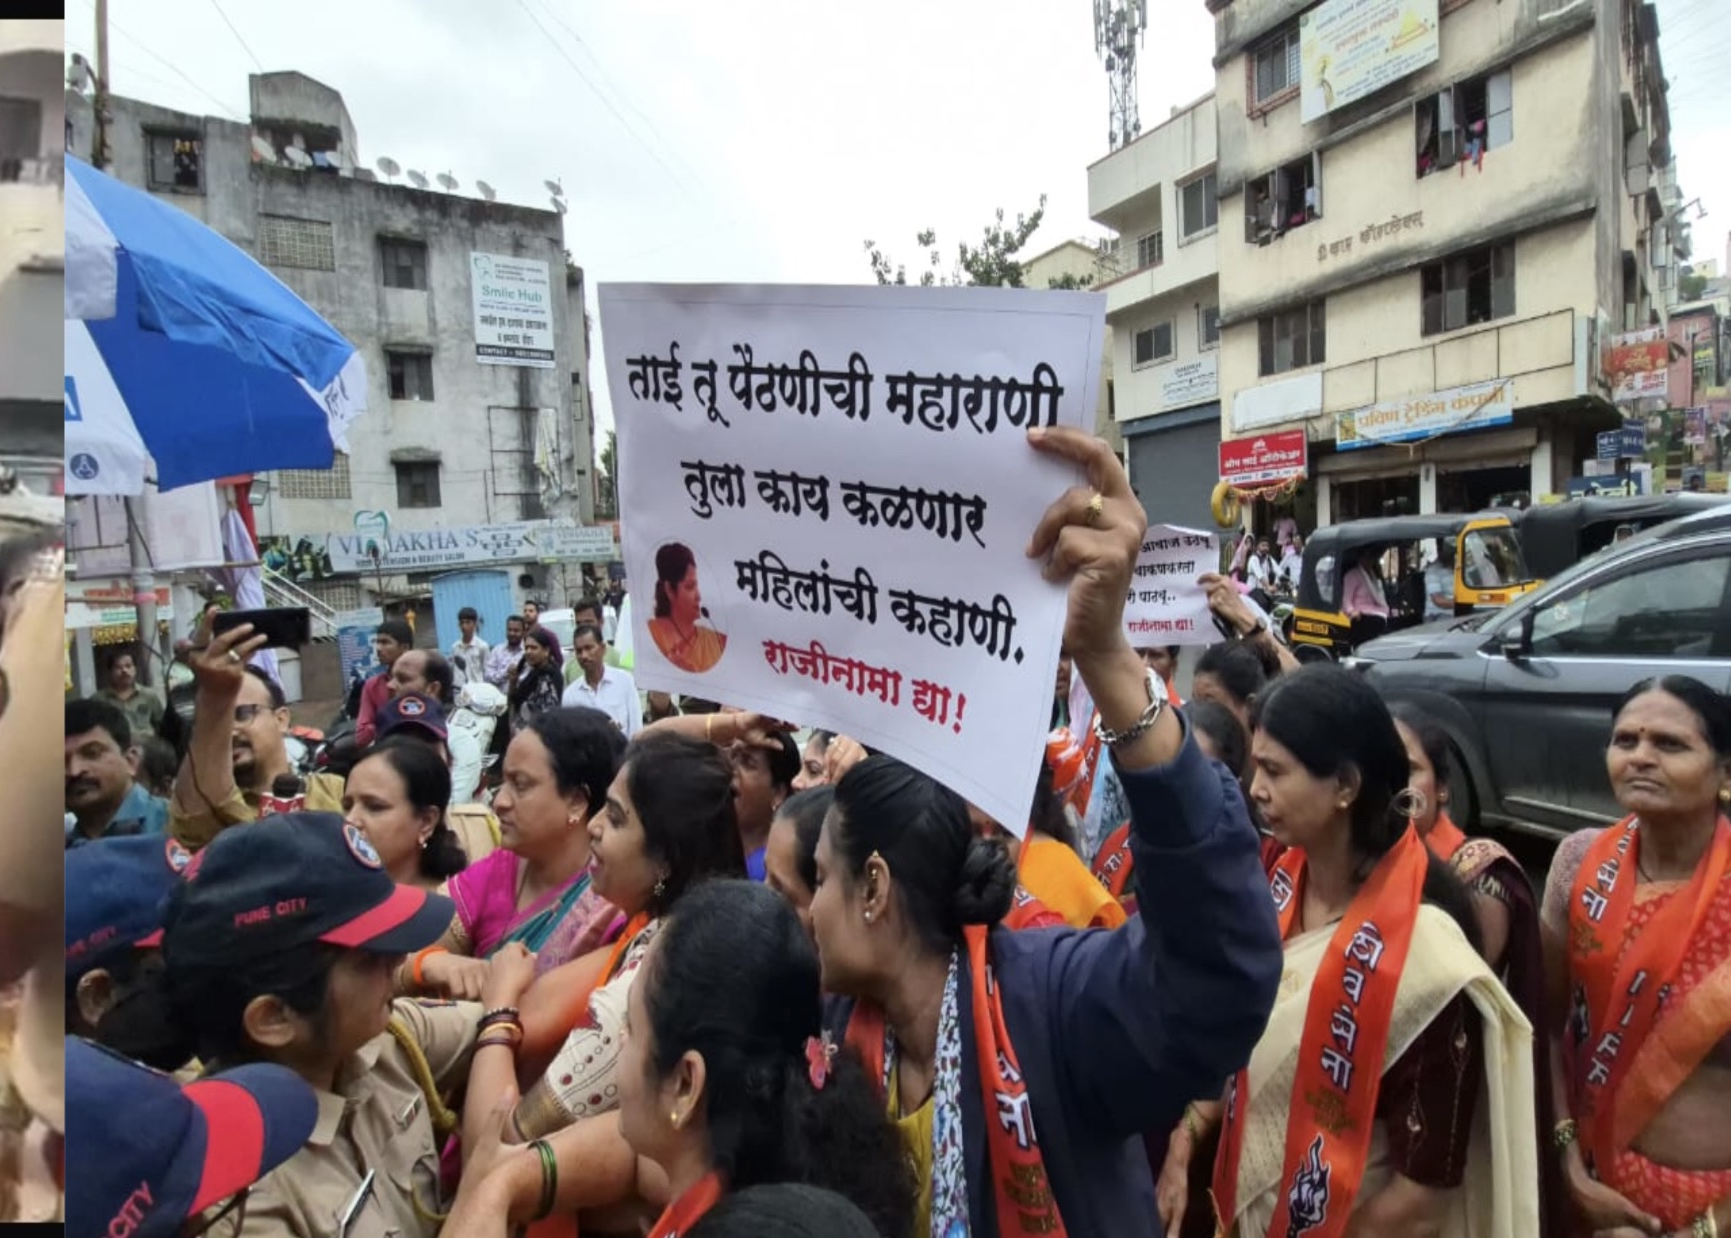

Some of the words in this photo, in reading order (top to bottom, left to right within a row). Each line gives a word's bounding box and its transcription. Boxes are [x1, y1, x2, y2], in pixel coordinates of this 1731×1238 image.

[626, 341, 683, 414] ताई
[691, 359, 730, 428] तू
[727, 344, 873, 421] पैठणीची
[885, 362, 1064, 434] महाराणी
[339, 528, 479, 555] VIAKHA'S
[681, 459, 746, 519] तुला
[754, 469, 829, 520] काय
[840, 481, 986, 547] कळणार
[734, 549, 878, 623] महिलांची
[889, 588, 1025, 665] कहाणी.
[762, 639, 901, 706] राजीनामा
[911, 678, 967, 735] द्या!
[234, 907, 272, 929] PUNE
[274, 897, 309, 919] CITY
[1321, 920, 1386, 1092] शिवसेना
[107, 1179, 154, 1238] CITY
